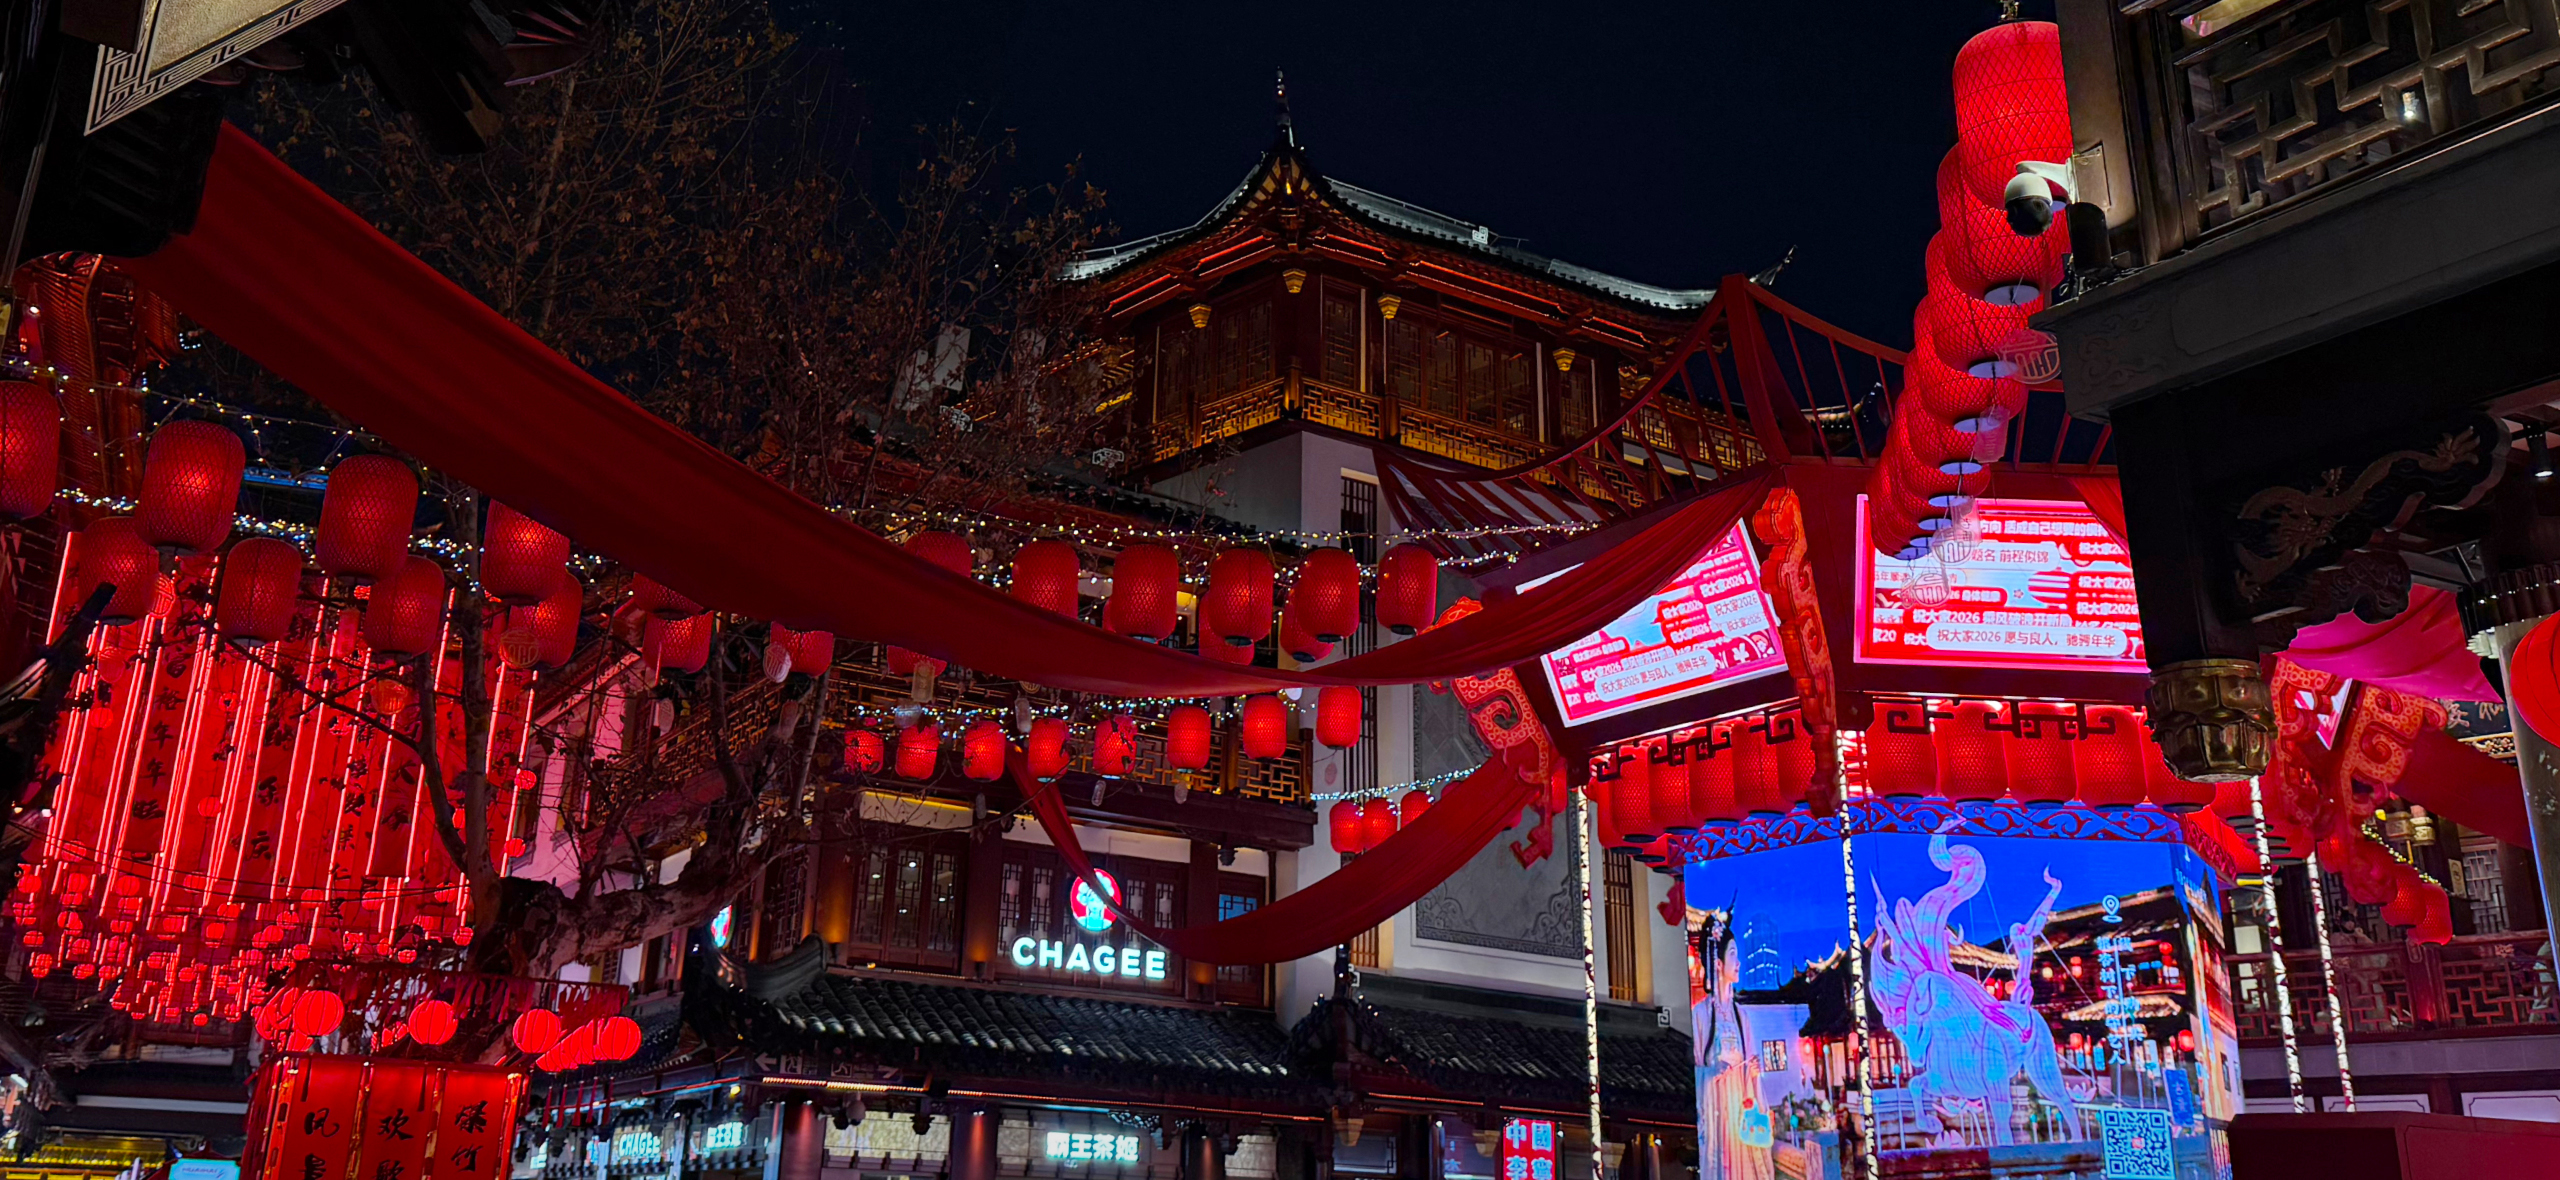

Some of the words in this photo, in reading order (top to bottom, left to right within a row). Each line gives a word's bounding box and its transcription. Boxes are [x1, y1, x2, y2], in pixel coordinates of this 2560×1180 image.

[2000, 550, 2049, 563] 前程似锦
[1913, 608, 1980, 624] 祝大家2026
[2076, 602, 2138, 615] 祝大家2026
[1937, 629, 2001, 643] 祝大家2026
[1012, 936, 1166, 979] CHAGEE
[1046, 1131, 1139, 1161] 霸王茶姬
